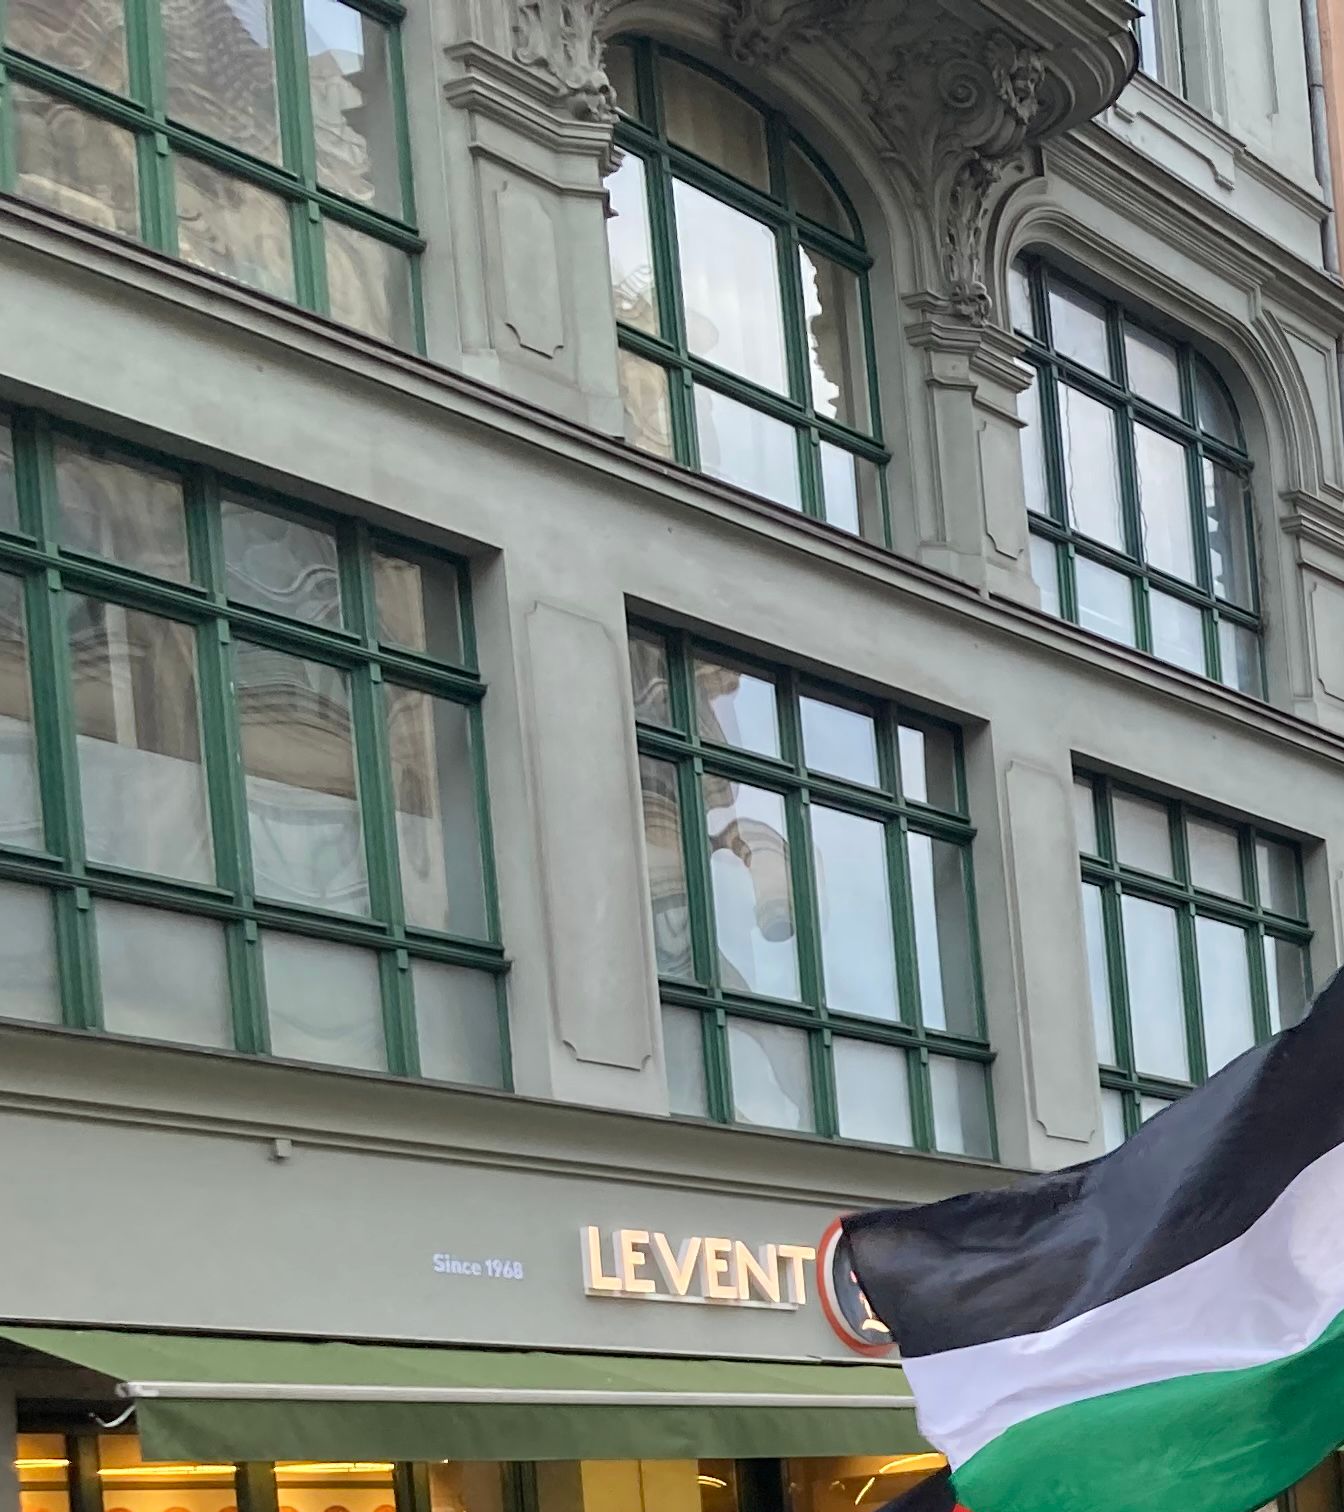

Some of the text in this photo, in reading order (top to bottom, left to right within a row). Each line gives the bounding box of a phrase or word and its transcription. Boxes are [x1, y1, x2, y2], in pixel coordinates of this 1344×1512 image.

[433, 1253, 523, 1279] Since 1968
[582, 1225, 816, 1305] LEVENT
